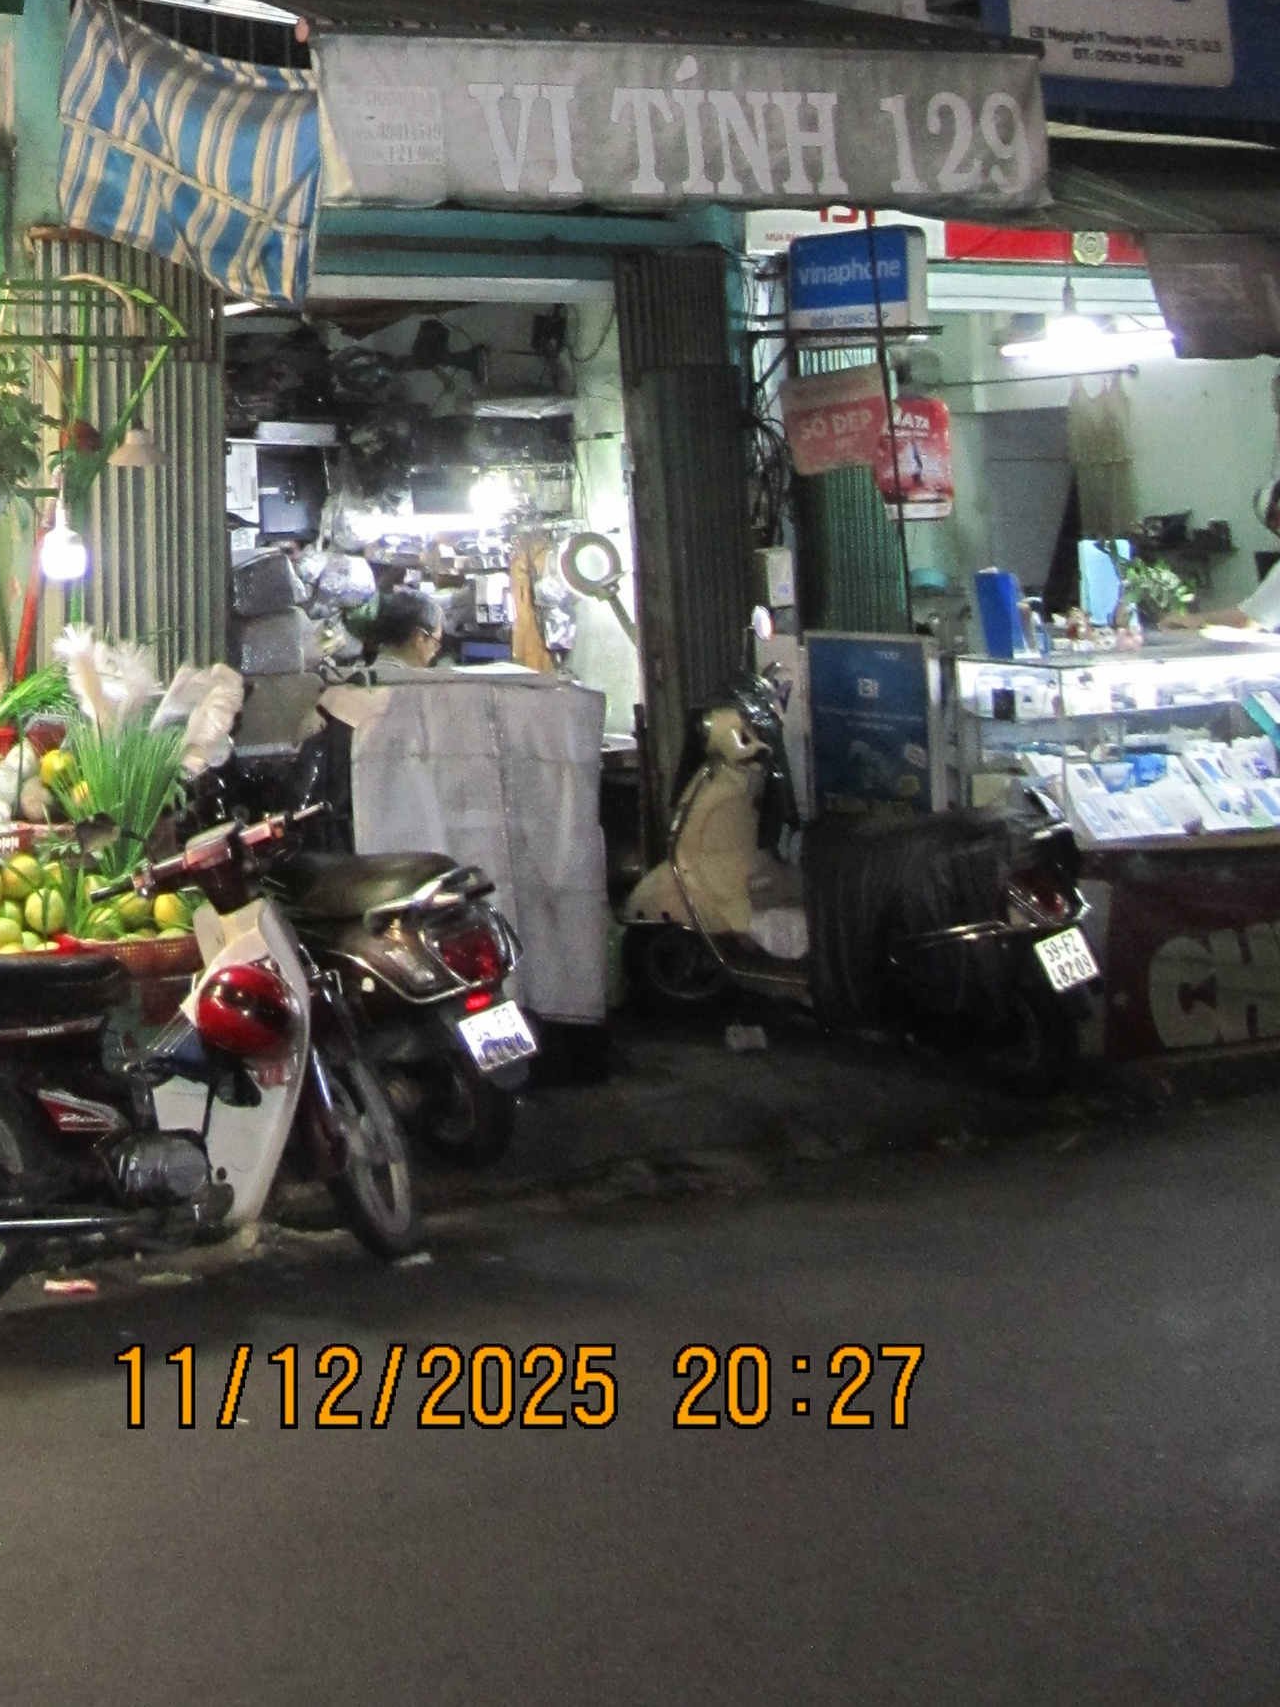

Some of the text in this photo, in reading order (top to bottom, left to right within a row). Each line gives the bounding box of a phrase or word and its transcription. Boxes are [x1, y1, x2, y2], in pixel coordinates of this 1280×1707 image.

[468, 83, 583, 194] VI
[610, 54, 849, 194] TÍNH
[880, 93, 1029, 195] 129
